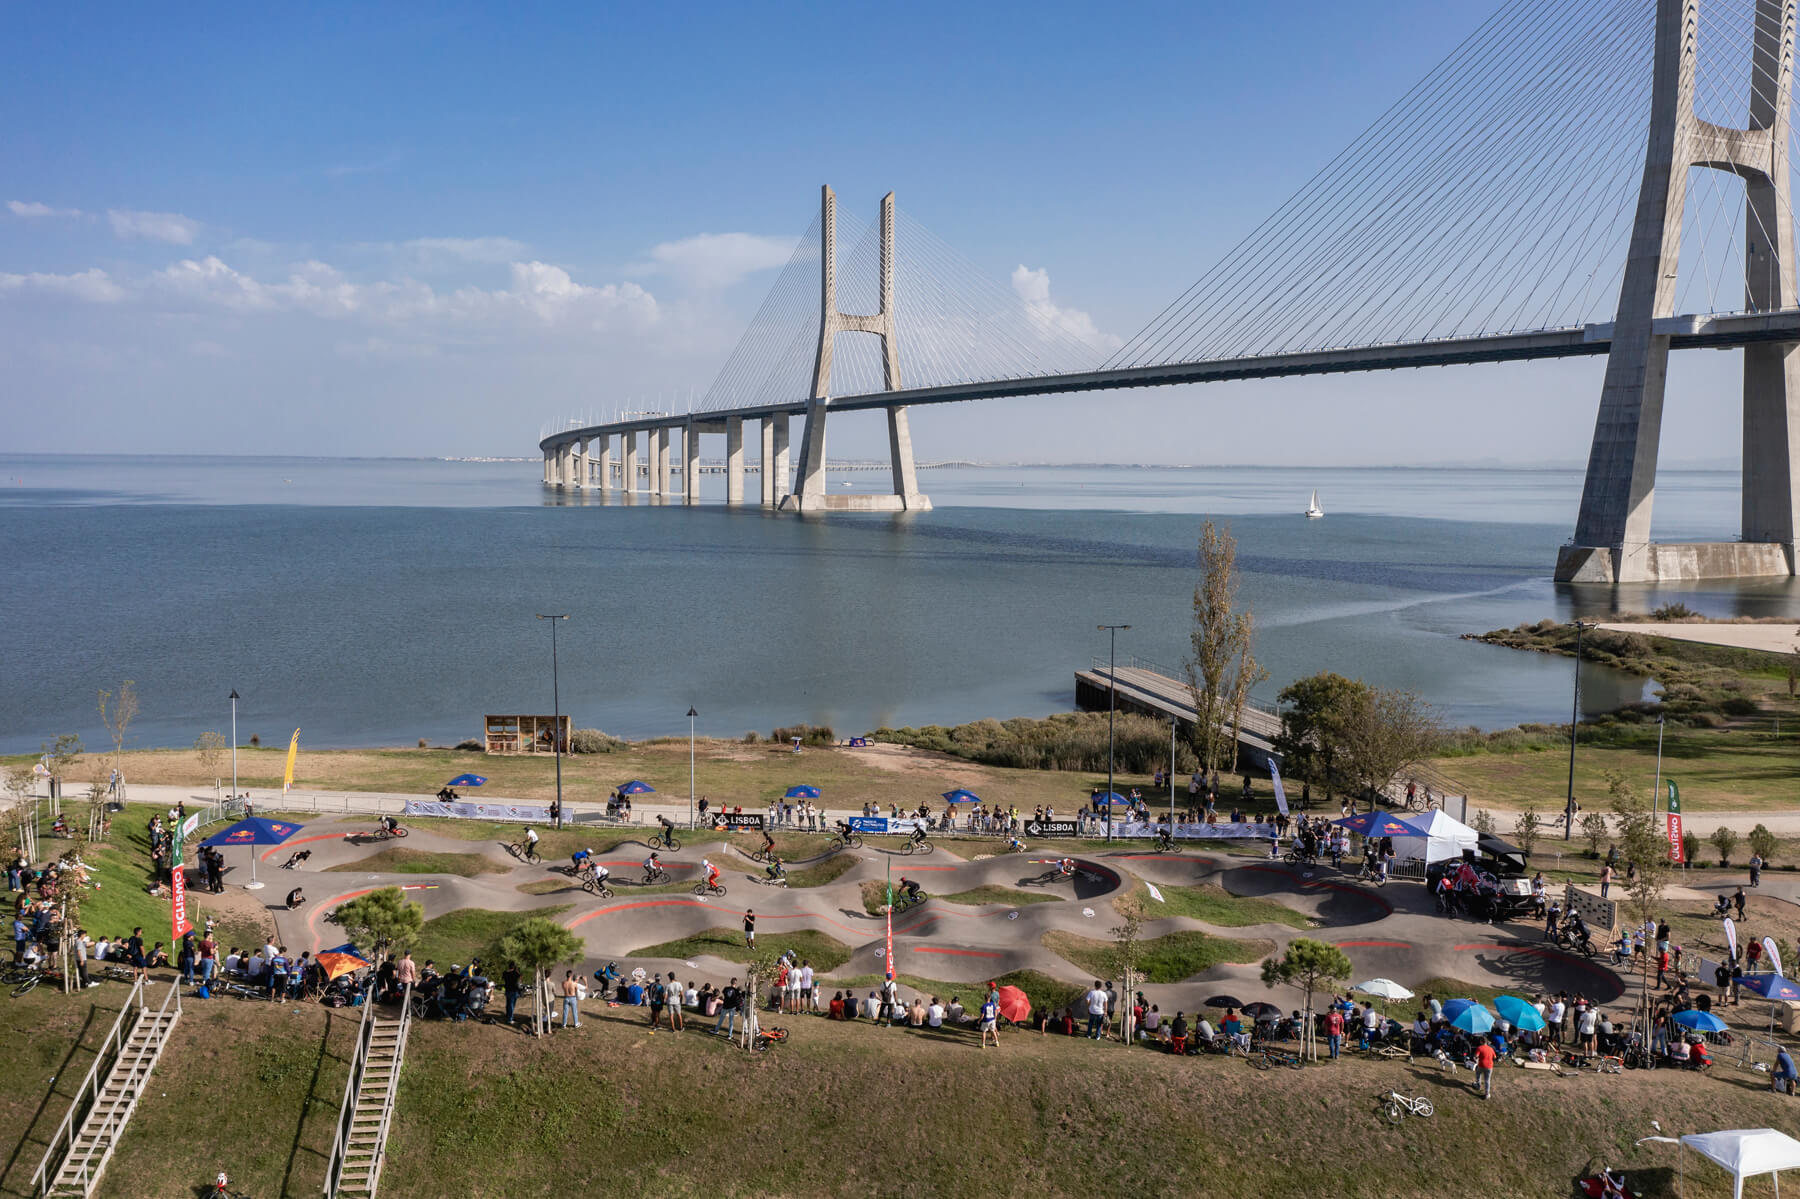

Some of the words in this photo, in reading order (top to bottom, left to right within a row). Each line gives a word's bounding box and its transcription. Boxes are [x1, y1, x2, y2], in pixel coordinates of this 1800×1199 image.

[730, 816, 761, 825] LISBOA
[1043, 823, 1074, 831] LISBOA
[175, 871, 185, 932] CICLISMO
